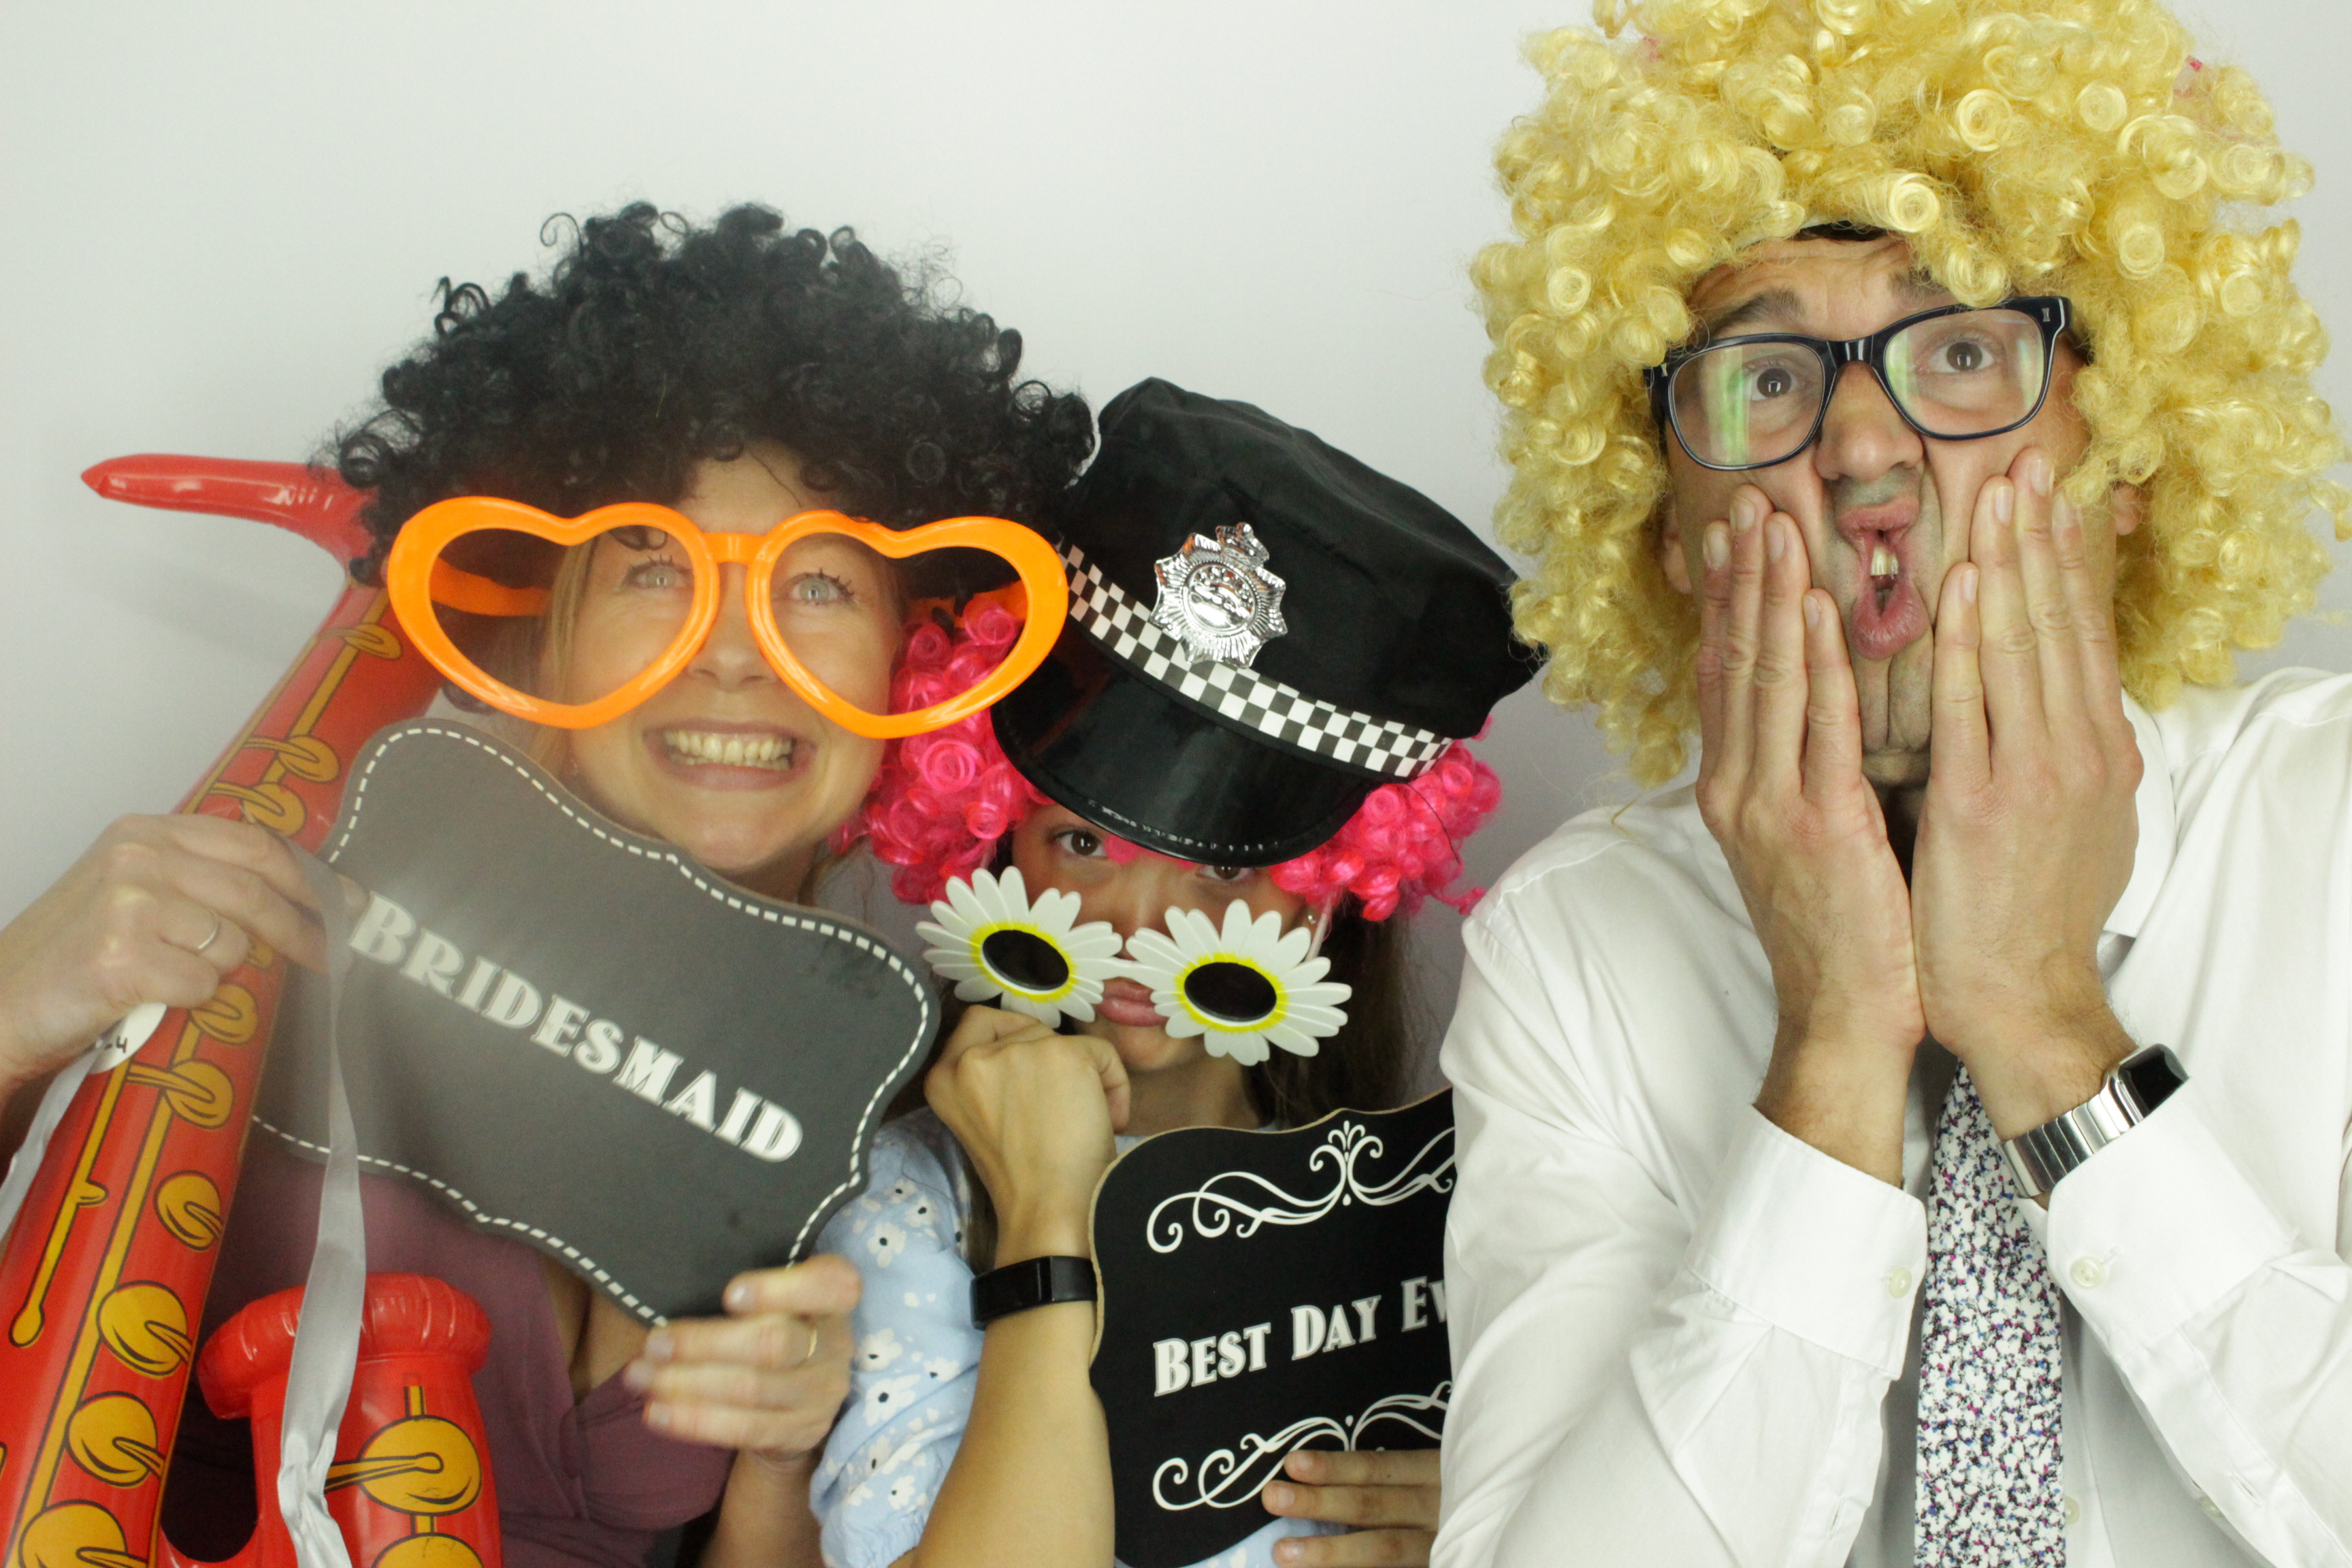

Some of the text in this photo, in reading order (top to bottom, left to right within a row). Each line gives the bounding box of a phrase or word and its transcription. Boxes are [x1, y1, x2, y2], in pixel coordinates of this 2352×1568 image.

[349, 892, 803, 1162] BRIDESMAID
[1153, 1322, 1271, 1397] BEST
[1291, 1294, 1382, 1361] DAY
